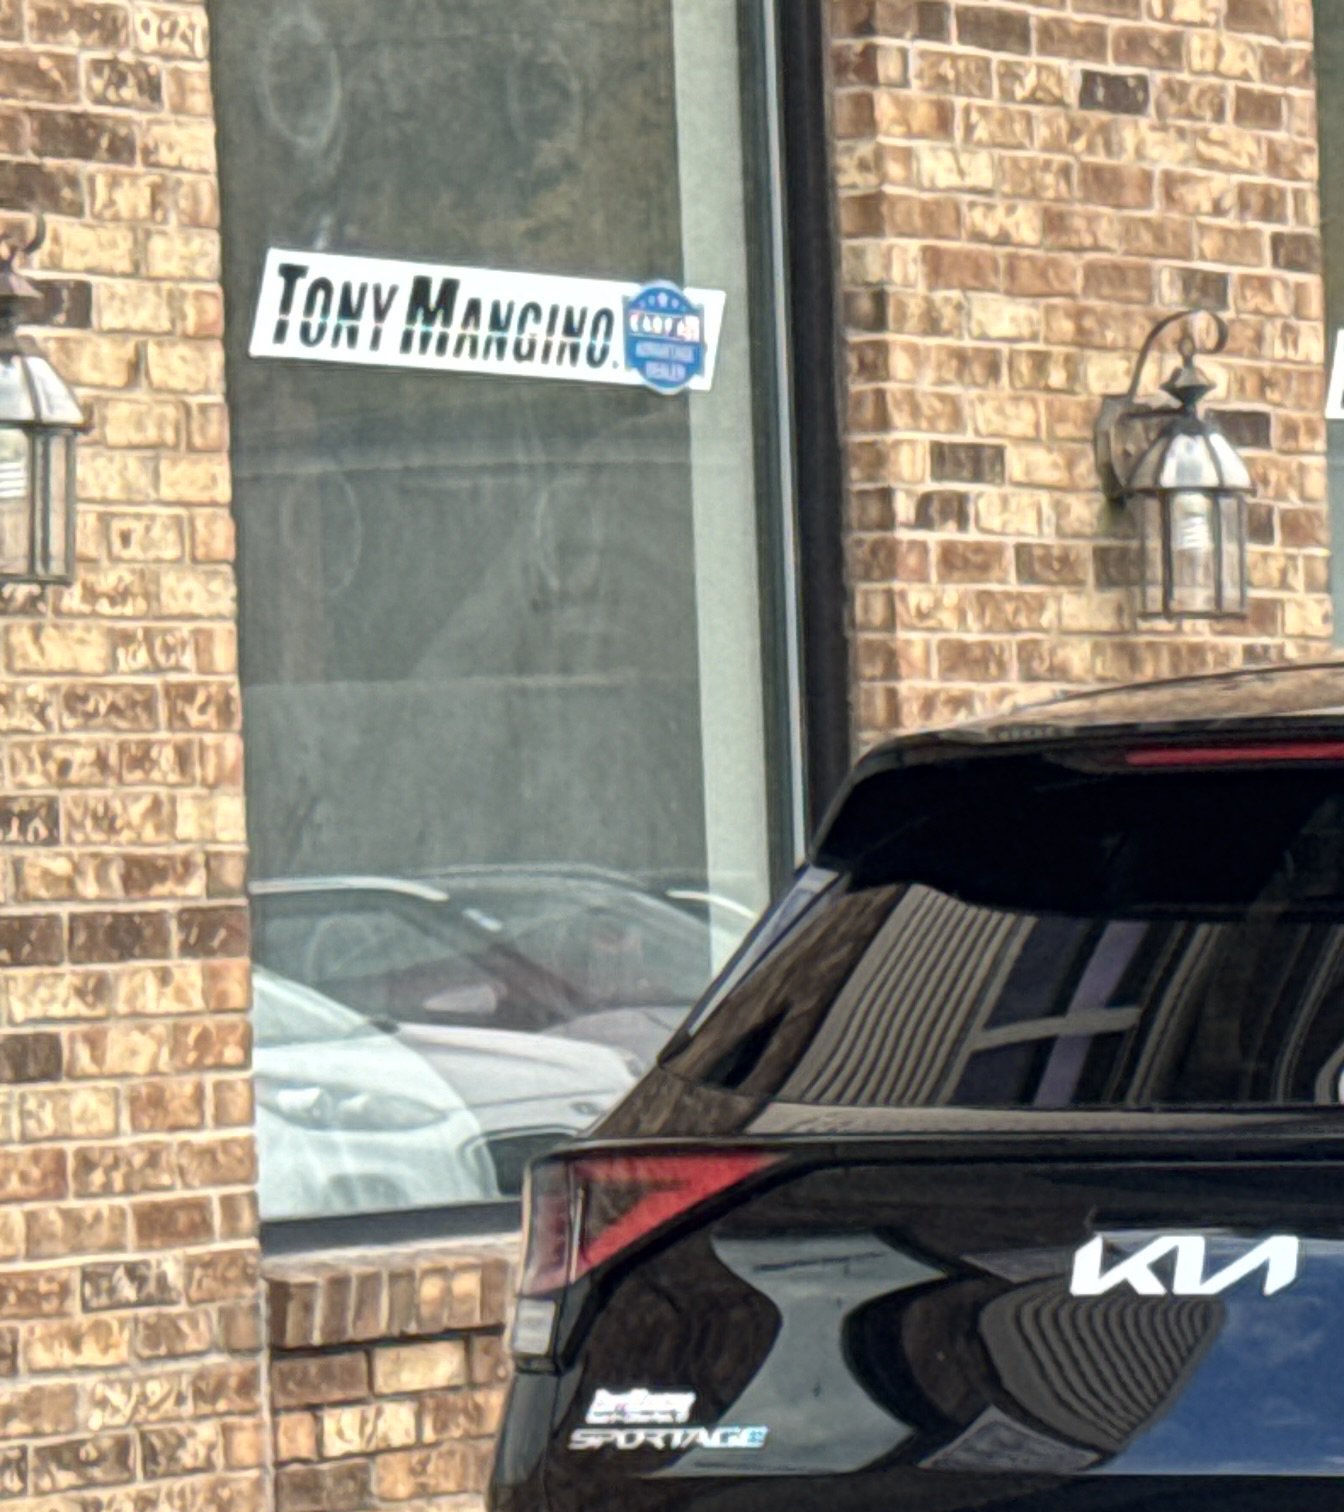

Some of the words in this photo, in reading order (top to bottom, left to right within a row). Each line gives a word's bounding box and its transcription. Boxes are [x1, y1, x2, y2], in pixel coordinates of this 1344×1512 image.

[272, 262, 399, 351] TONY
[399, 275, 616, 369] MANGINO
[1069, 1234, 1300, 1297] KIA
[567, 1425, 769, 1450] SPORTAGE
